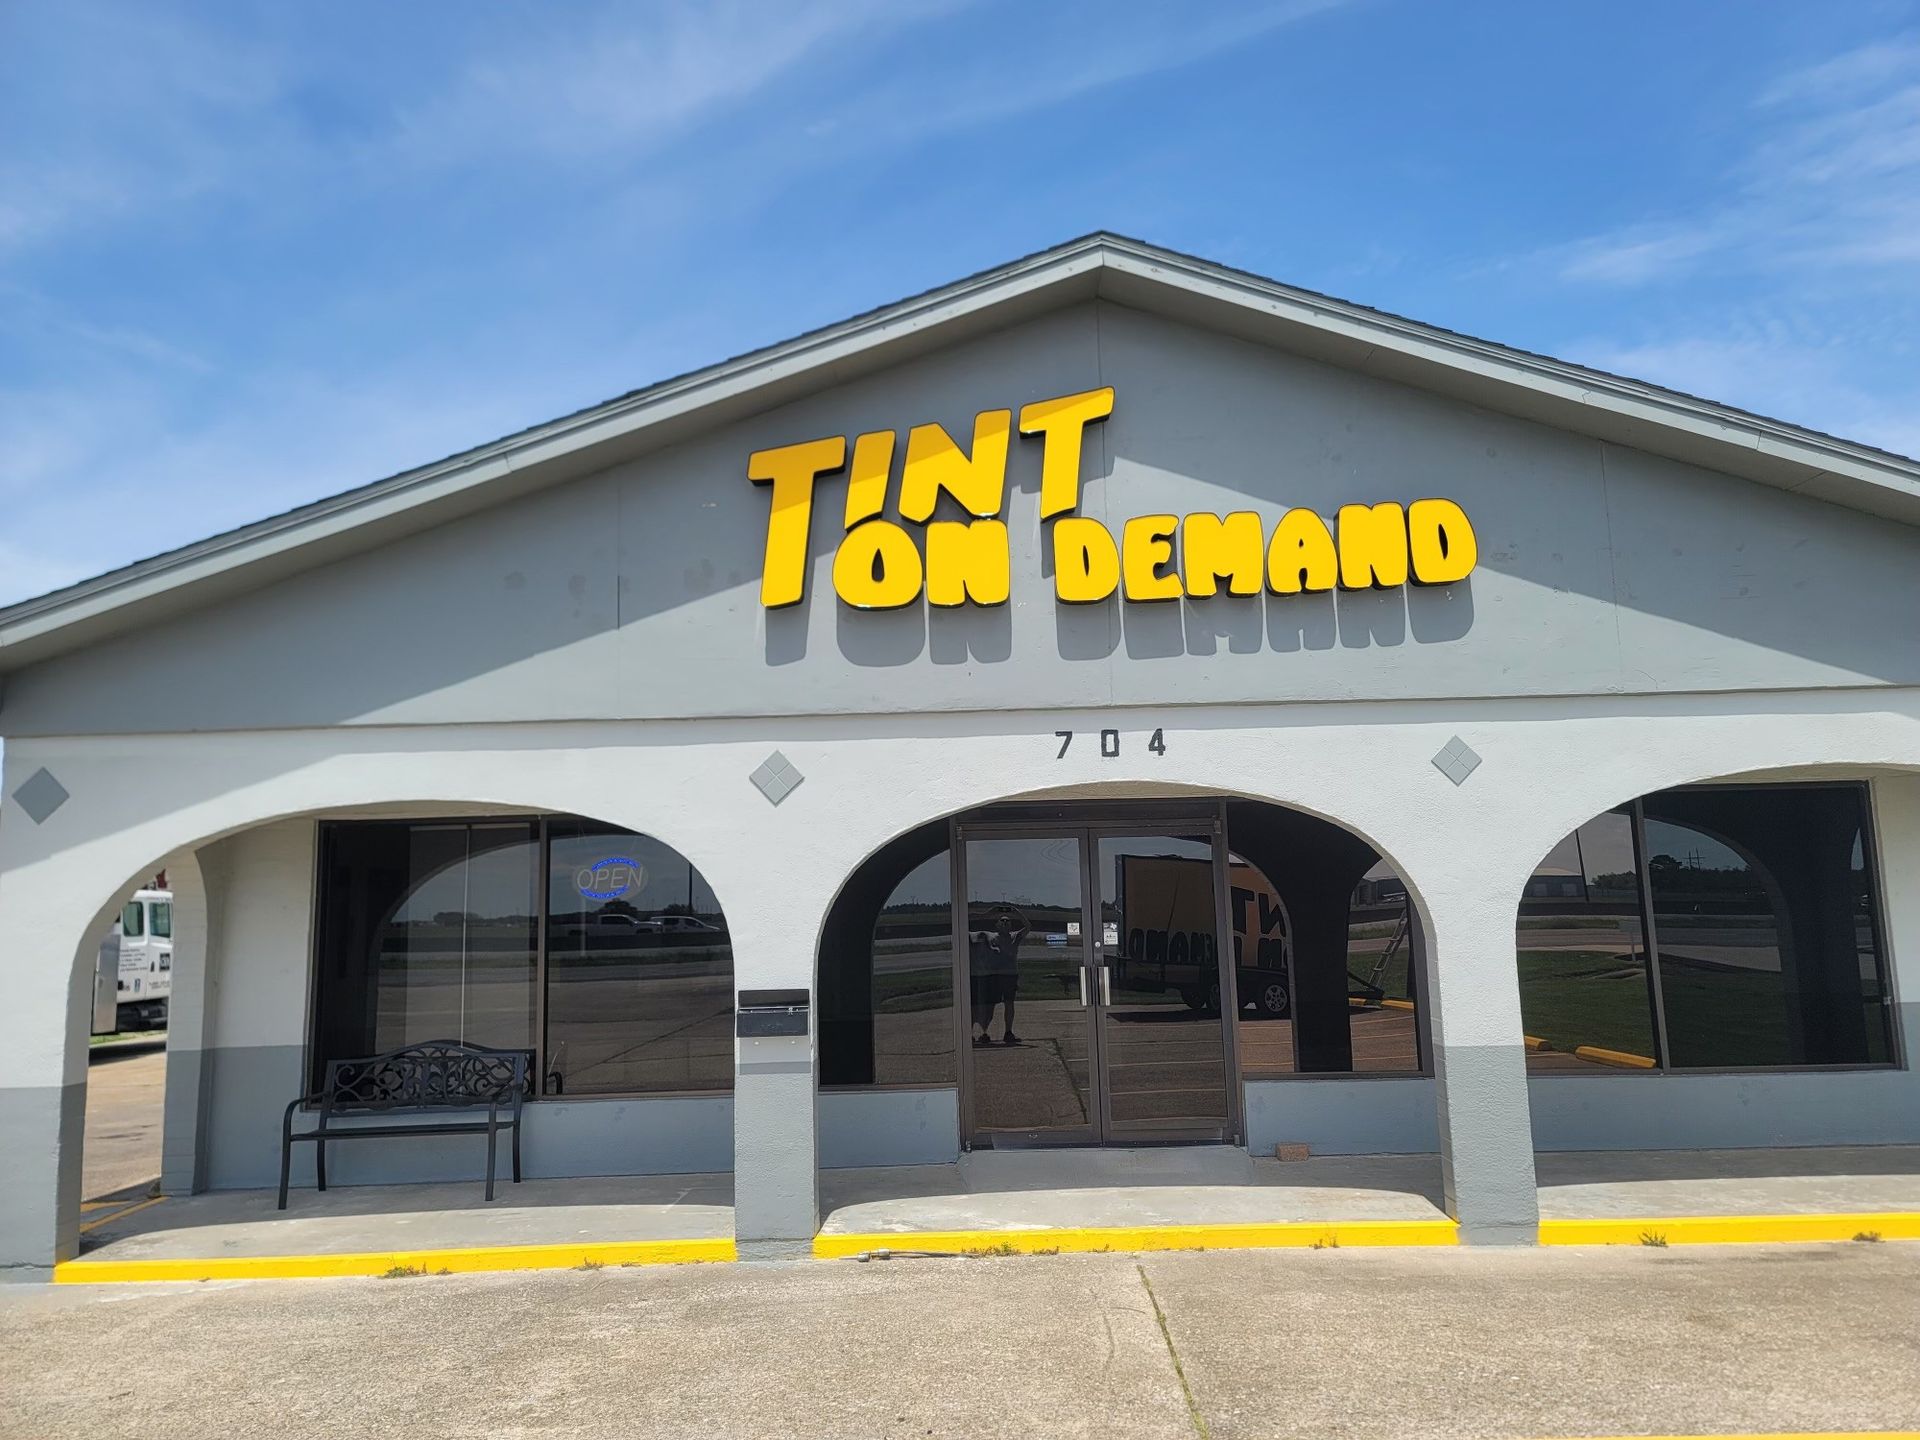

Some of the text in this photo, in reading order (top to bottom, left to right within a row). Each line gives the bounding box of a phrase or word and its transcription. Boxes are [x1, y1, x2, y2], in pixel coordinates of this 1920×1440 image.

[747, 386, 1116, 610] TINT
[832, 497, 1479, 611] ON DEMAND
[1055, 728, 1167, 759] 704
[576, 866, 644, 890] OPEN
